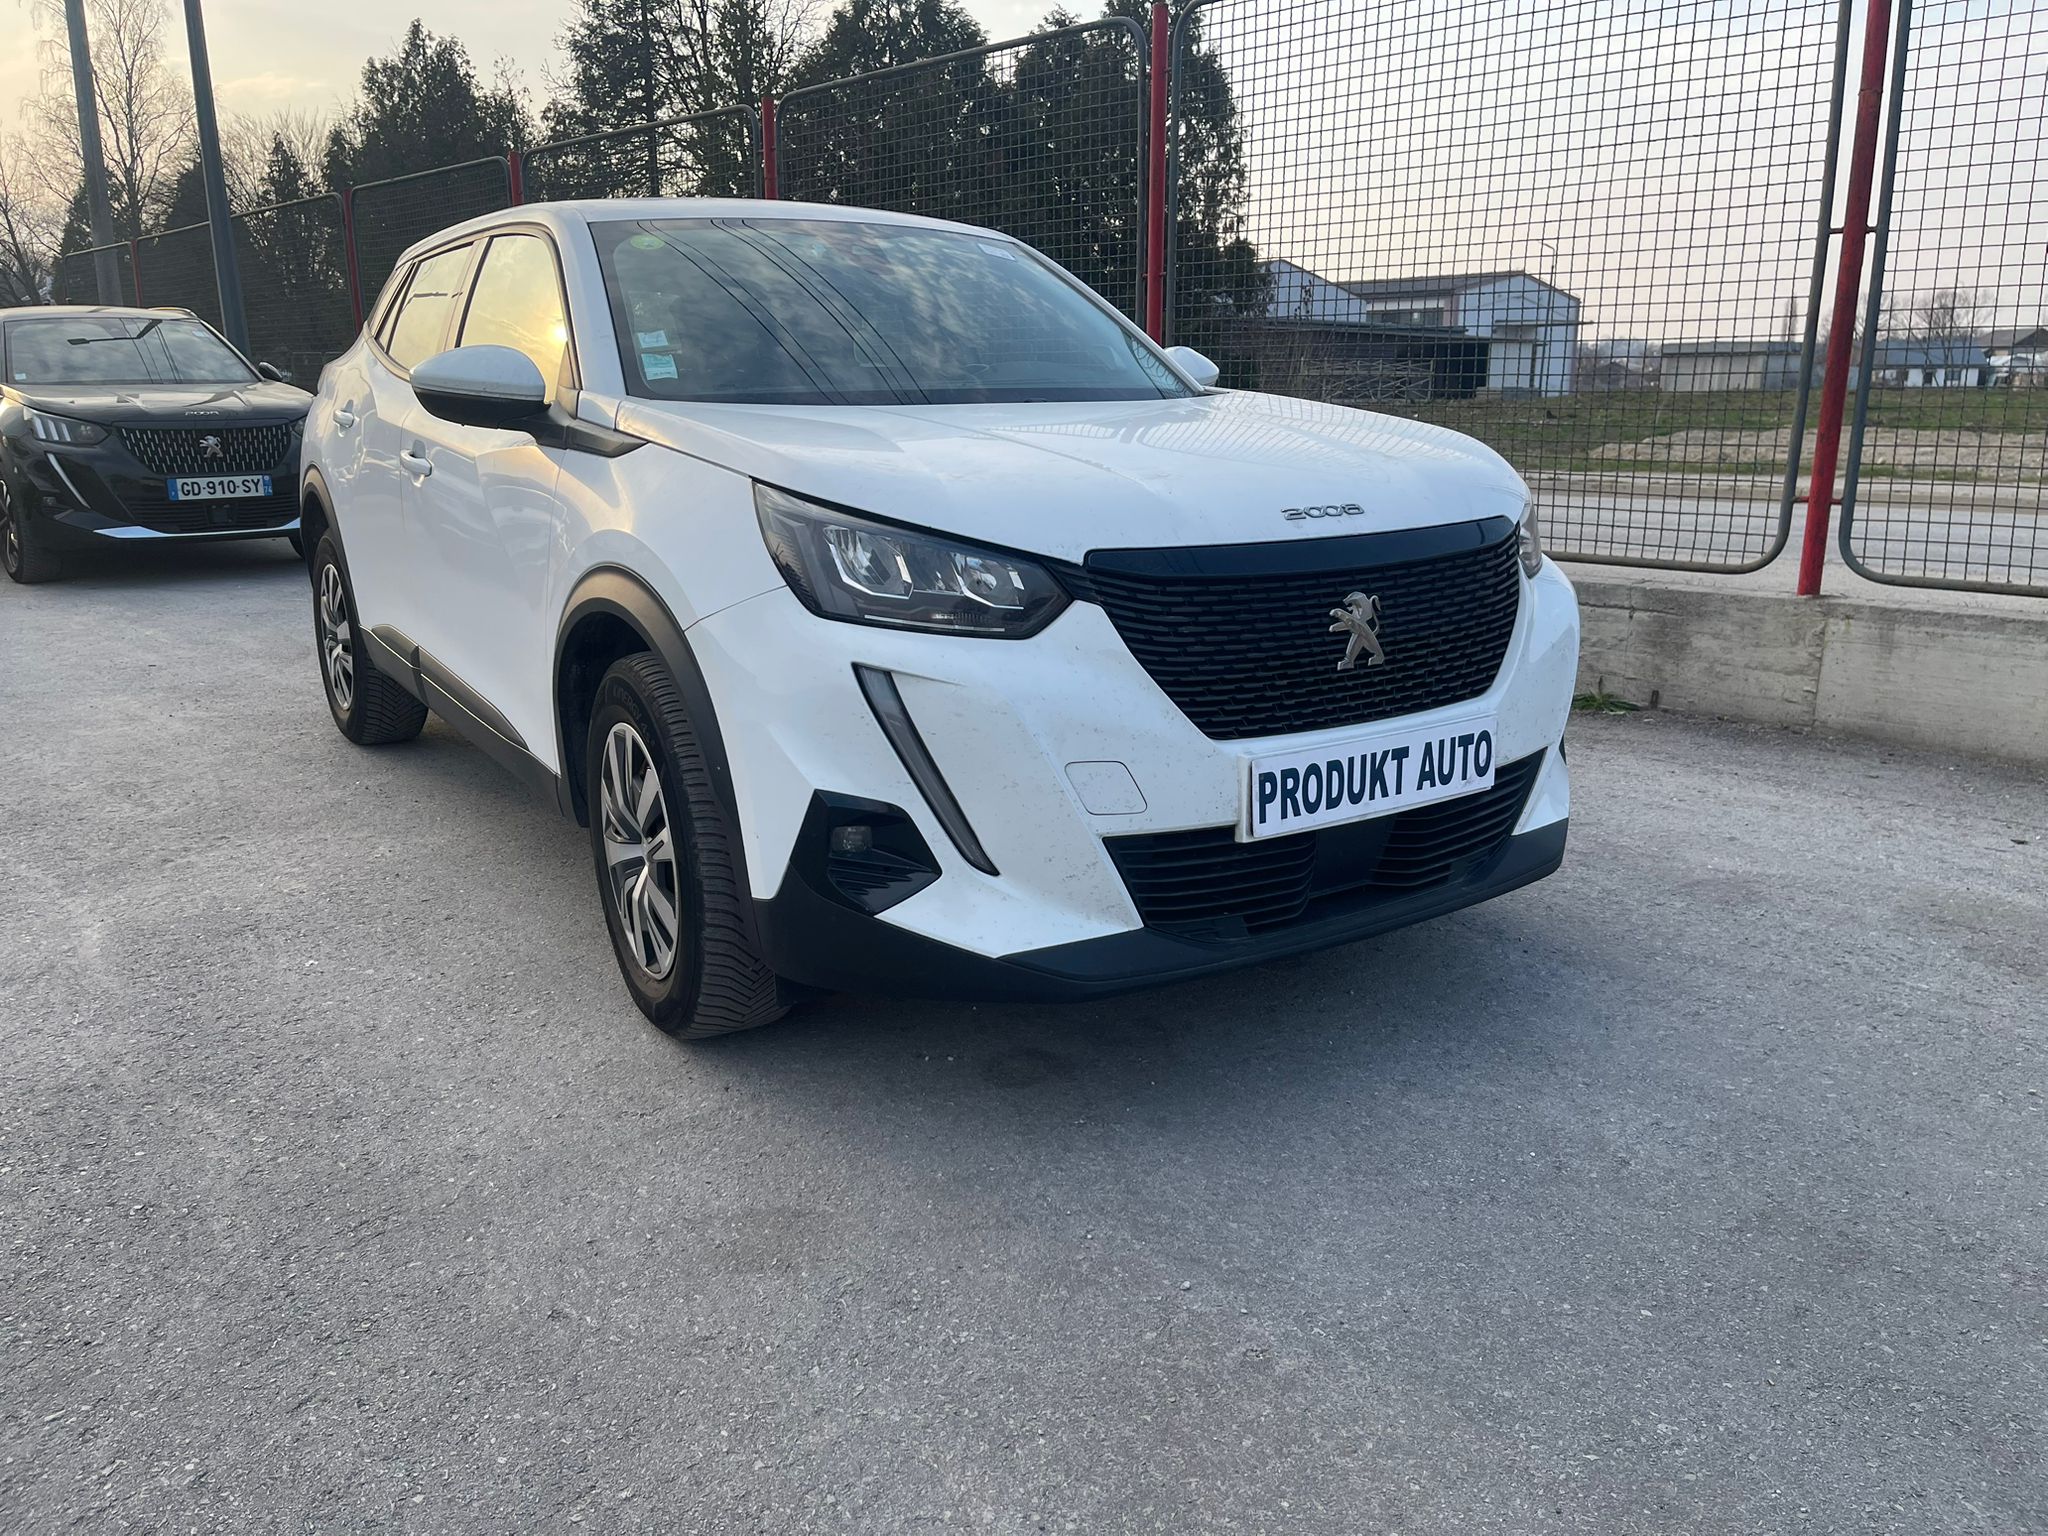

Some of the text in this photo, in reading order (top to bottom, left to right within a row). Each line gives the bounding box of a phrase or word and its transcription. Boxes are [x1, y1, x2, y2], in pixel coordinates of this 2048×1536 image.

[180, 478, 260, 497] GD-910-SY
[1281, 503, 1365, 520] 2008
[1258, 729, 1492, 824] PRODUKT AUTO
